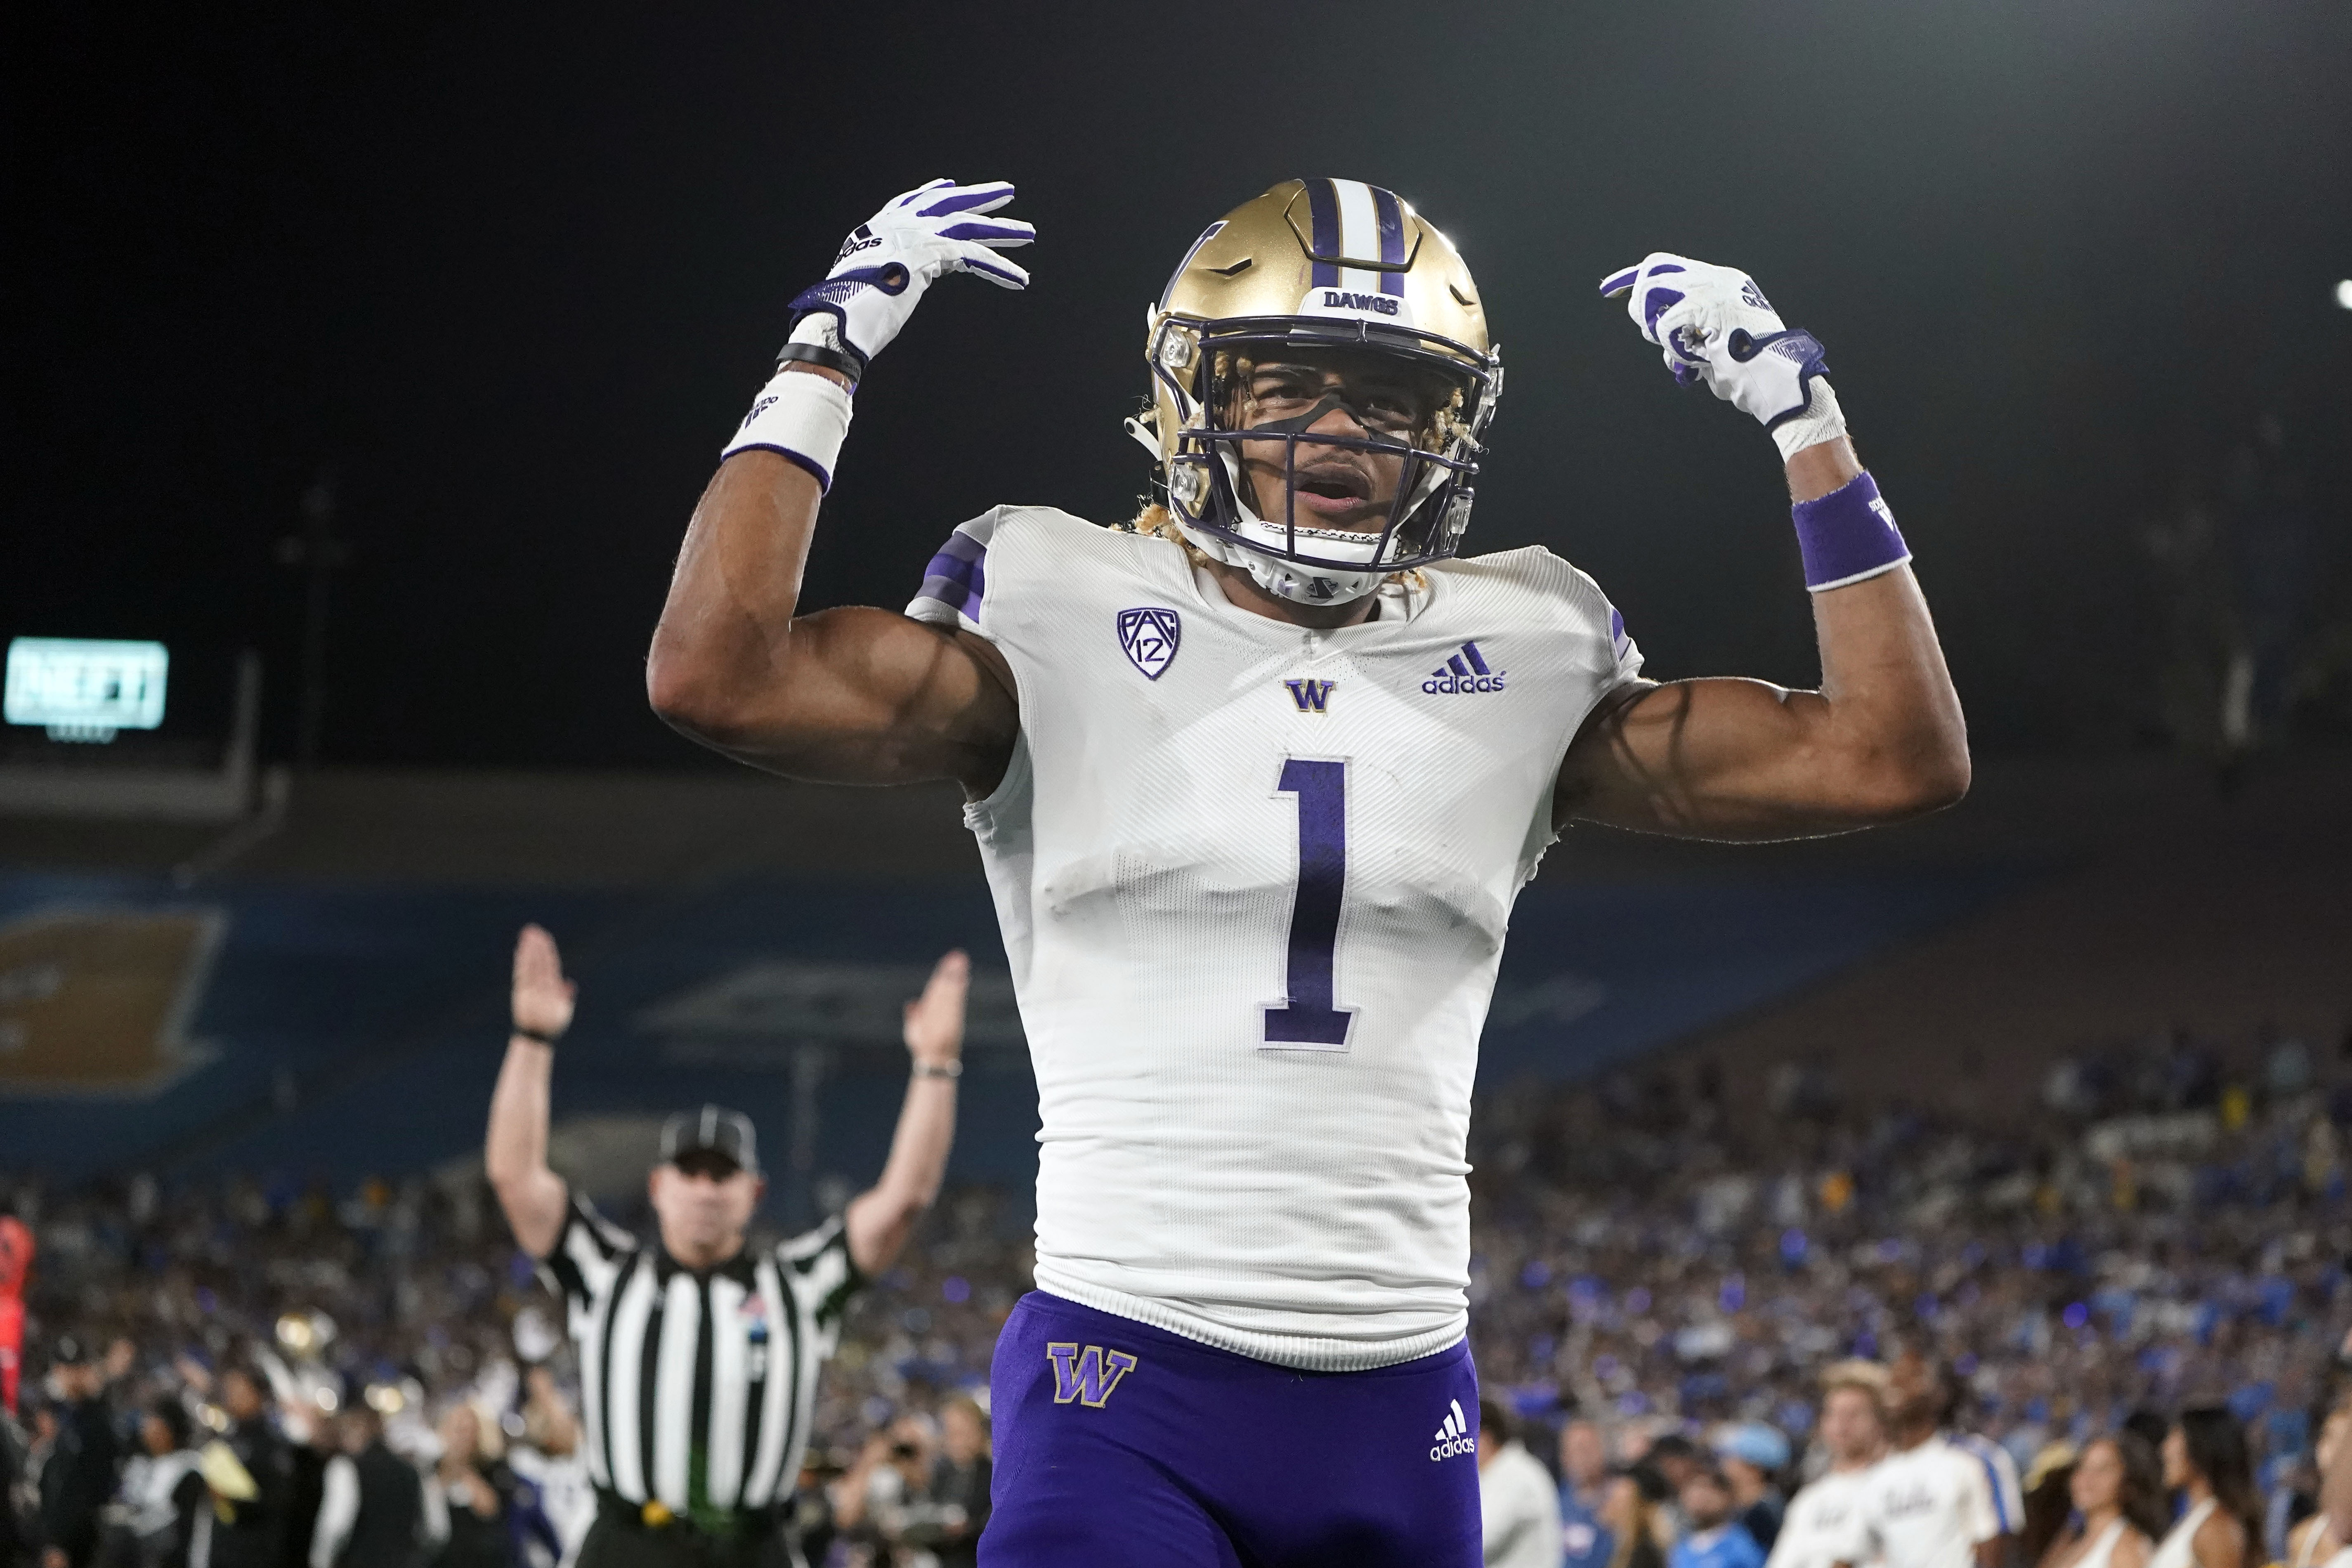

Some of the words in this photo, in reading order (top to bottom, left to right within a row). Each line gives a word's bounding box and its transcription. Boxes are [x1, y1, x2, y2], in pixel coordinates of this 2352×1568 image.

[1324, 291, 1398, 316] DAWGS
[1120, 611, 1176, 651] PAC
[1136, 638, 1165, 662] 12
[1284, 679, 1336, 713] W
[1422, 675, 1504, 694] adidas
[1259, 755, 1360, 1051] 1
[1047, 1342, 1138, 1408] W
[1430, 1434, 1475, 1462] adidas
